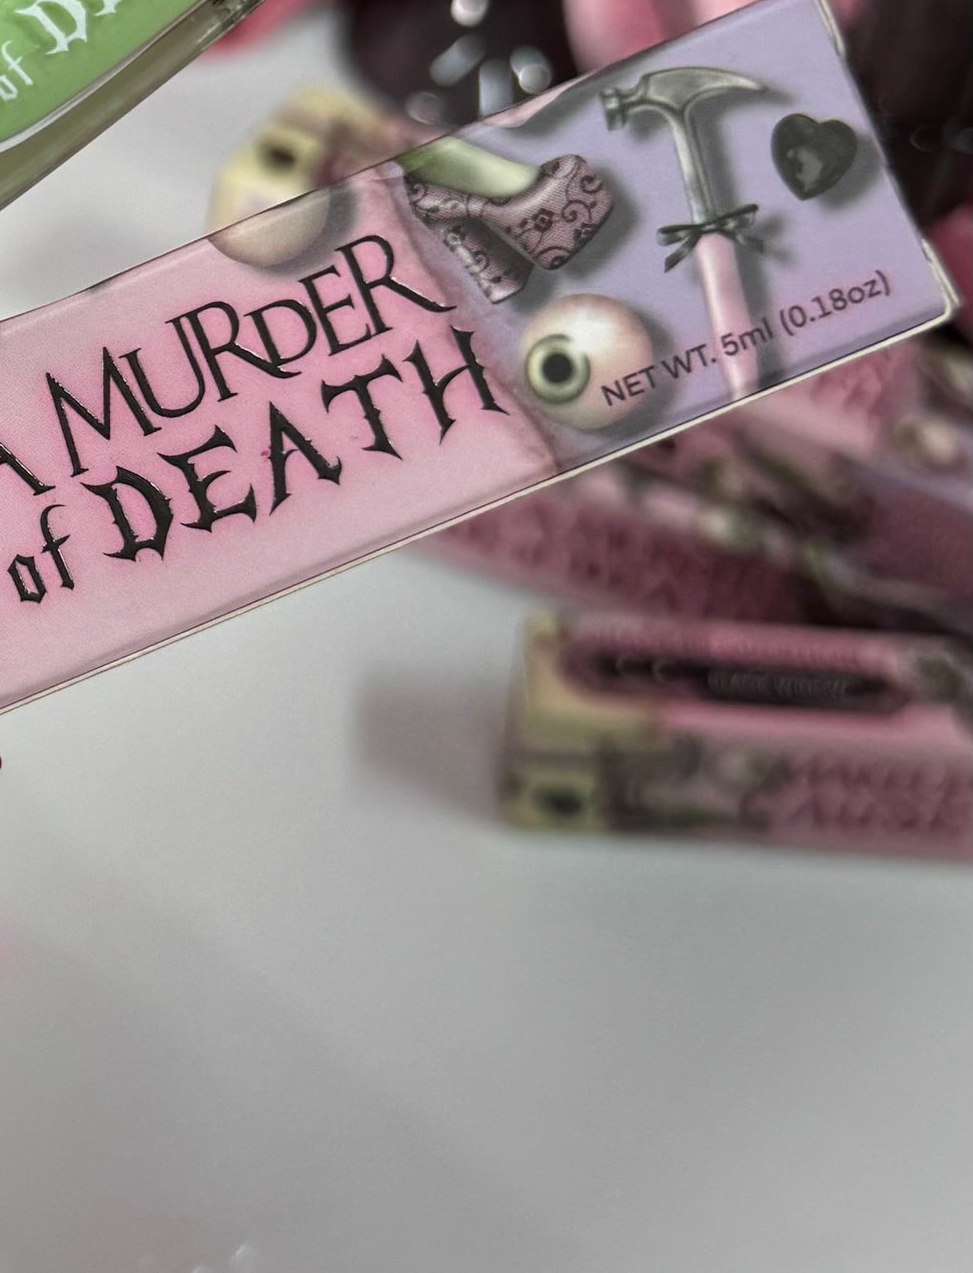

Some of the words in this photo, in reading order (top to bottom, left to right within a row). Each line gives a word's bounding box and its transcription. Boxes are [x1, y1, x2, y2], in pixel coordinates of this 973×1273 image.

[46, 235, 456, 478] MURDER
[601, 365, 657, 407] NET
[660, 344, 717, 379] WT.
[721, 317, 774, 357] 5ml
[779, 270, 891, 337] (0.18oz)
[7, 505, 75, 604] of
[81, 326, 510, 561] DEATH
